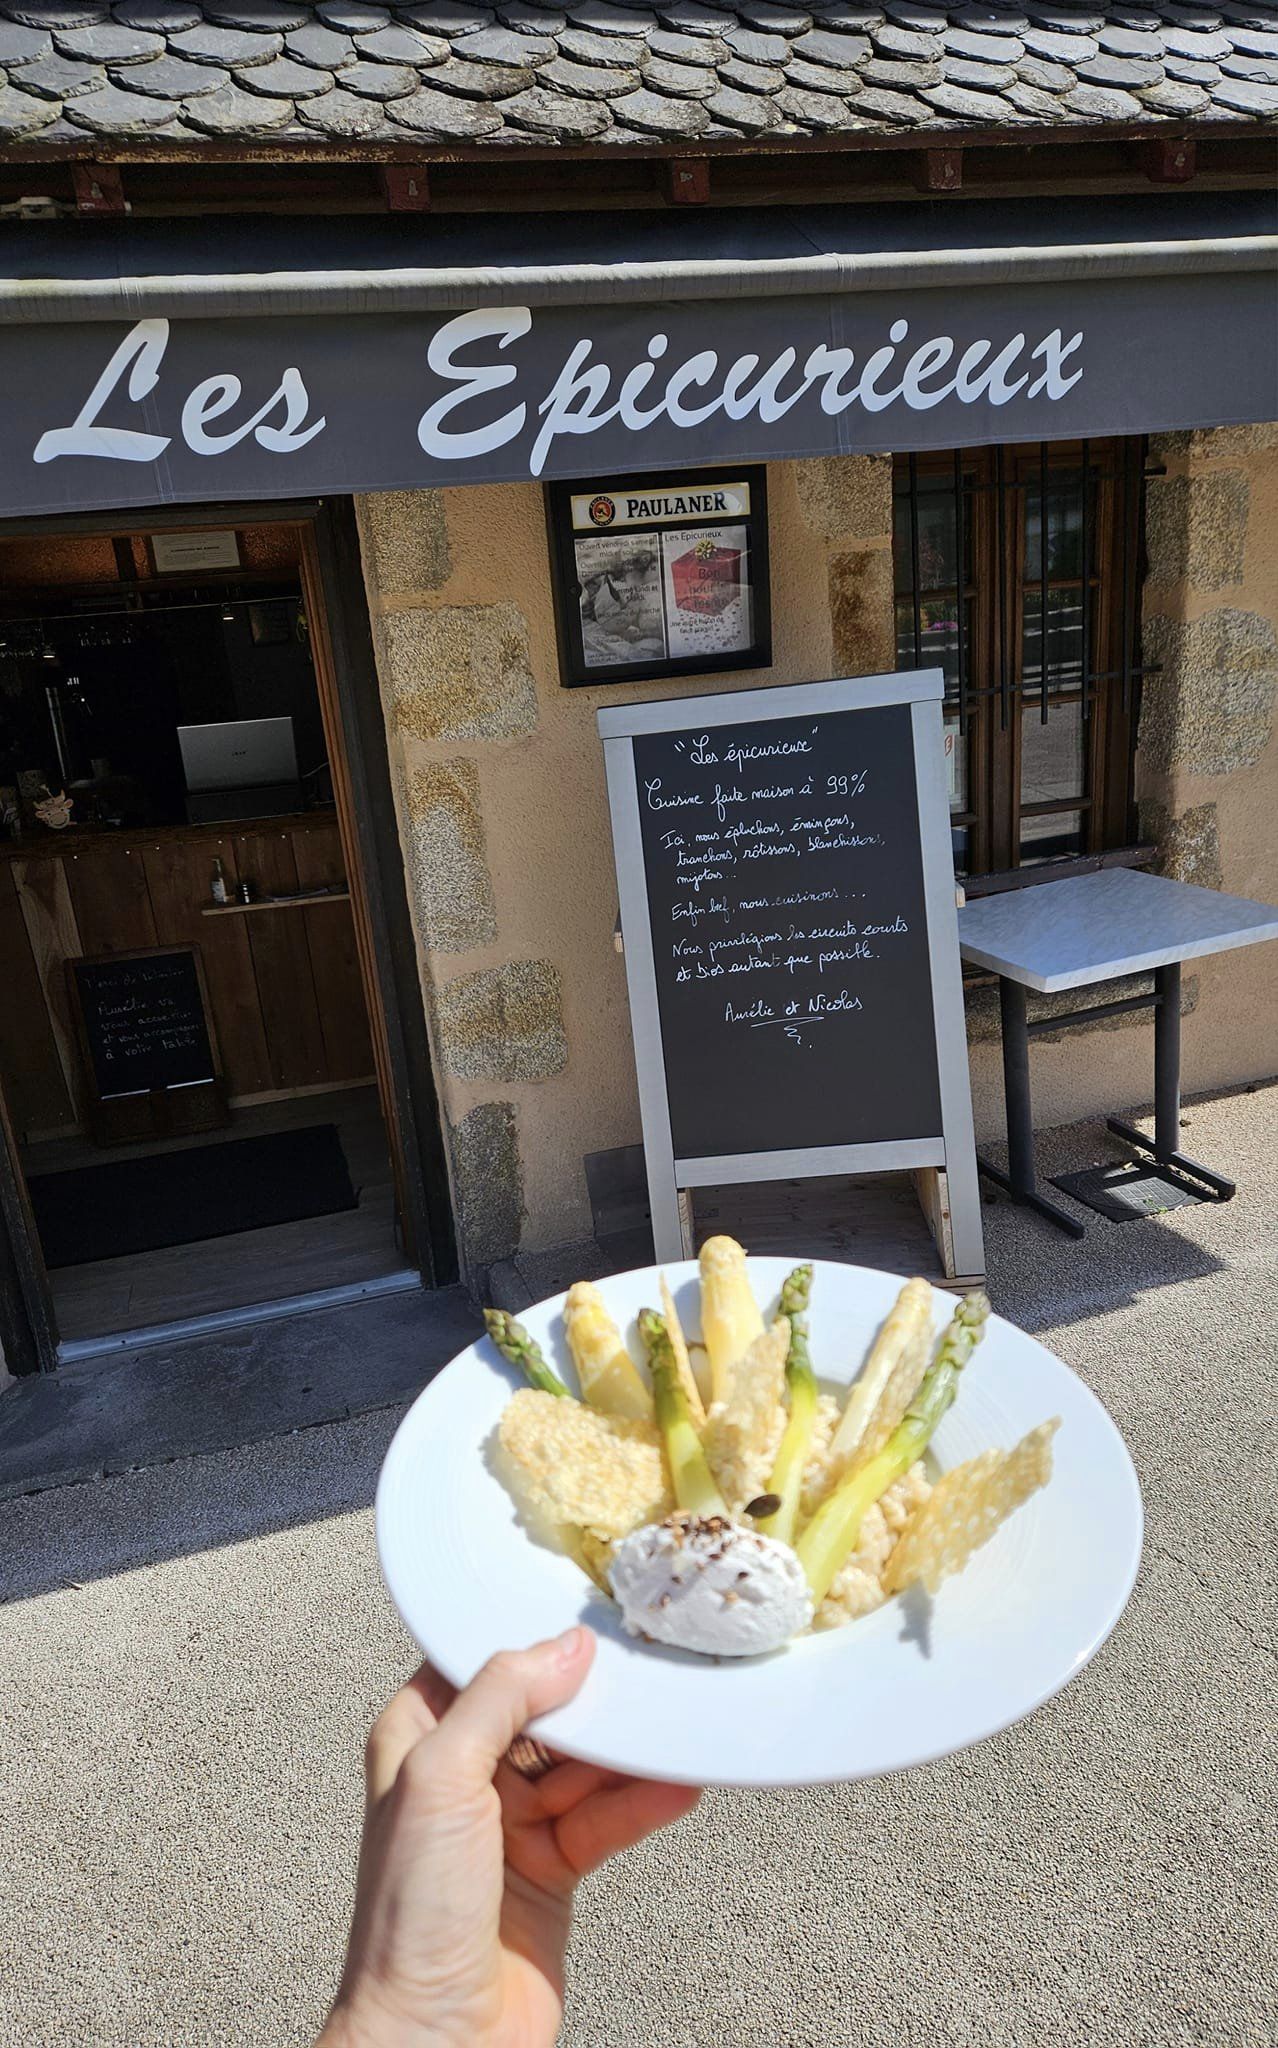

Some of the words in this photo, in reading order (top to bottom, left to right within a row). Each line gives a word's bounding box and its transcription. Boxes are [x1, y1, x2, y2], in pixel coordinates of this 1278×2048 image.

[34, 318, 326, 463] Les
[418, 306, 1084, 476] Epicurieux
[626, 491, 727, 518] PAULANER
[665, 532, 679, 542] Les
[681, 530, 722, 542] Epicurieux
[699, 567, 720, 579] Bon
[645, 778, 704, 810] Cuisine
[711, 784, 747, 822] faite
[752, 786, 794, 801] maison
[799, 776, 813, 795] à
[826, 769, 868, 797] 99%
[695, 831, 720, 844] nous
[724, 820, 785, 846] épluchons,
[676, 849, 737, 867] tranchons,
[743, 841, 801, 859] rôtissons,
[672, 903, 705, 926] Enfin
[740, 898, 769, 910] nous
[673, 939, 704, 958] Nous
[709, 932, 783, 962] privilégions
[787, 924, 805, 940] les
[809, 920, 857, 939] circuits
[861, 915, 909, 936] courts
[676, 967, 691, 982] et
[728, 953, 780, 972] autant
[784, 955, 812, 974] que
[819, 940, 880, 973] possible.
[725, 1002, 774, 1022] Aurélie
[786, 1003, 800, 1016] et
[809, 990, 862, 1012] Nicolas
